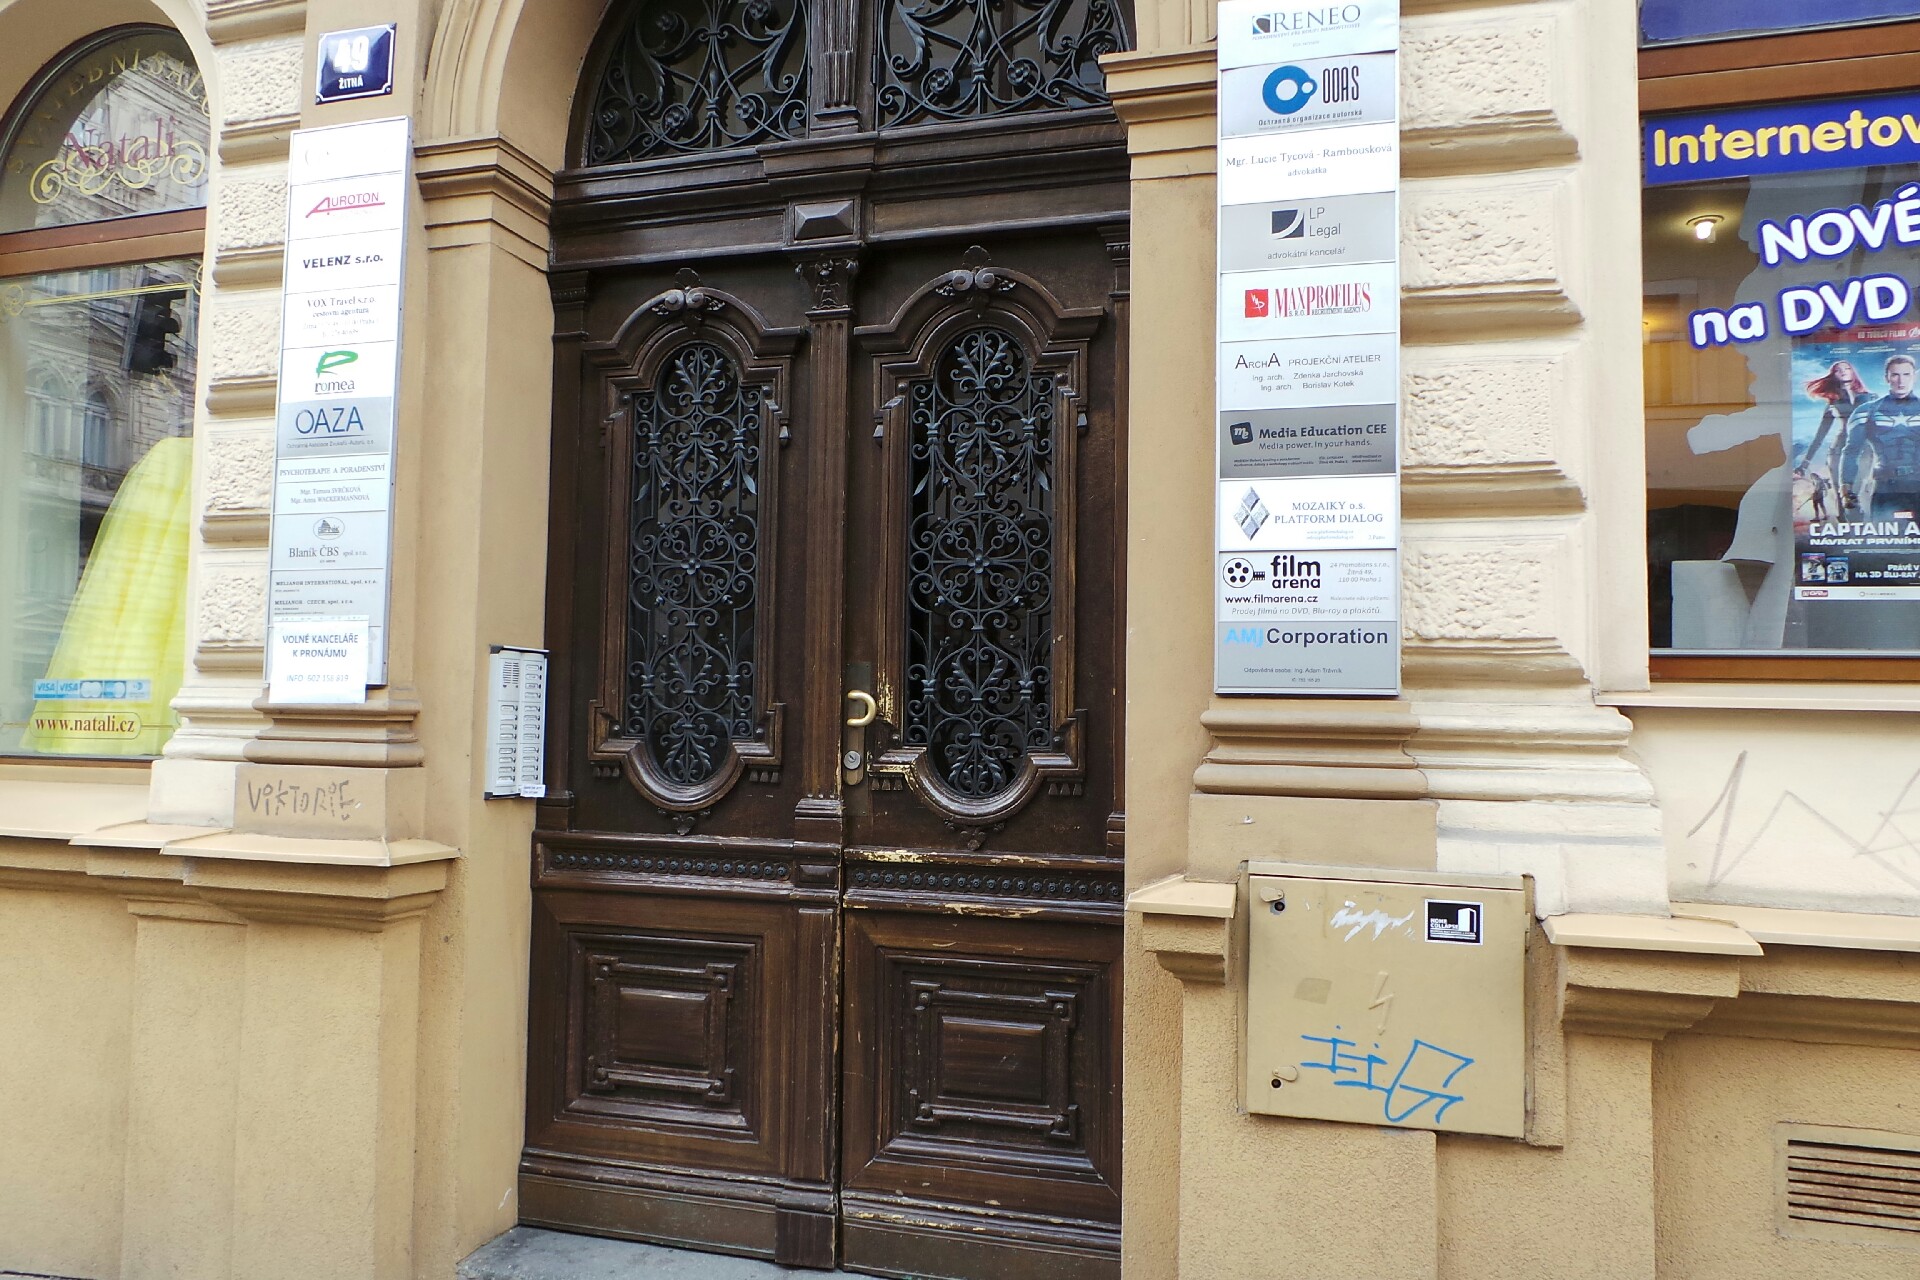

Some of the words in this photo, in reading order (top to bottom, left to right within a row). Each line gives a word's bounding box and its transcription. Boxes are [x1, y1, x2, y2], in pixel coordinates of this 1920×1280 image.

[1274, 4, 1361, 33] RENEO
[333, 35, 370, 73] 49
[338, 75, 364, 90] ŽITNÁ
[1322, 65, 1359, 104] OOAS
[61, 115, 176, 173] Natali
[1226, 157, 1249, 168] Mgr.
[1251, 155, 1277, 165] Lucie
[1279, 150, 1314, 163] Tycová
[1322, 143, 1392, 159] Rambousková
[306, 192, 385, 218] AUROTON
[1309, 207, 1326, 220] LP
[1309, 222, 1341, 239] Legal
[1761, 186, 1920, 265] NOVÉ
[1267, 247, 1308, 260] advokátní
[303, 255, 351, 269] VELENZ
[354, 254, 383, 264] s.r.o.
[330, 296, 356, 306] Travel
[1275, 282, 1371, 318] MAXPROFILES
[1692, 305, 1766, 346] na
[1781, 276, 1908, 332] DVD
[1288, 355, 1342, 367] PROJEKČNÍ
[1342, 354, 1381, 364] ATELIER
[314, 379, 356, 394] romea
[295, 406, 364, 434] OAZA
[1258, 427, 1298, 439] Media
[1300, 424, 1363, 437] Education
[1365, 423, 1387, 434] CEE
[1258, 442, 1284, 450] Media
[1324, 440, 1344, 449] your
[1344, 438, 1373, 447] hands.
[279, 467, 331, 477] PSYCHOTERAPIE
[332, 467, 339, 475] A
[340, 463, 386, 474] PORADENSTVÍ
[1292, 501, 1346, 511] MOZAIKY
[1348, 502, 1366, 510] o.s.
[1274, 513, 1336, 524] PLATFORM
[1339, 512, 1384, 523] DIALOG
[1809, 521, 1899, 537] CAPTAIN
[1809, 536, 1865, 546] NÁVRAT
[1866, 536, 1920, 545] PRVNÍH
[289, 547, 317, 558] Blaník
[319, 544, 339, 557] ČBS
[1270, 554, 1321, 577] film
[1272, 578, 1321, 589] arena
[1224, 594, 1319, 604] www.filmarena.cz
[1231, 607, 1256, 617] Prodej
[1312, 606, 1341, 617] Blu-ray
[282, 633, 310, 644] VOLNÉ
[311, 632, 359, 644] KANCELÁŘE
[1224, 627, 1264, 648] AMJ
[1266, 628, 1388, 648] Corporation
[292, 649, 299, 657] K
[300, 647, 348, 658] PRONÁJMU
[37, 683, 55, 692] VISA
[60, 682, 78, 692] VISA
[35, 715, 135, 733] www.natali.cz
